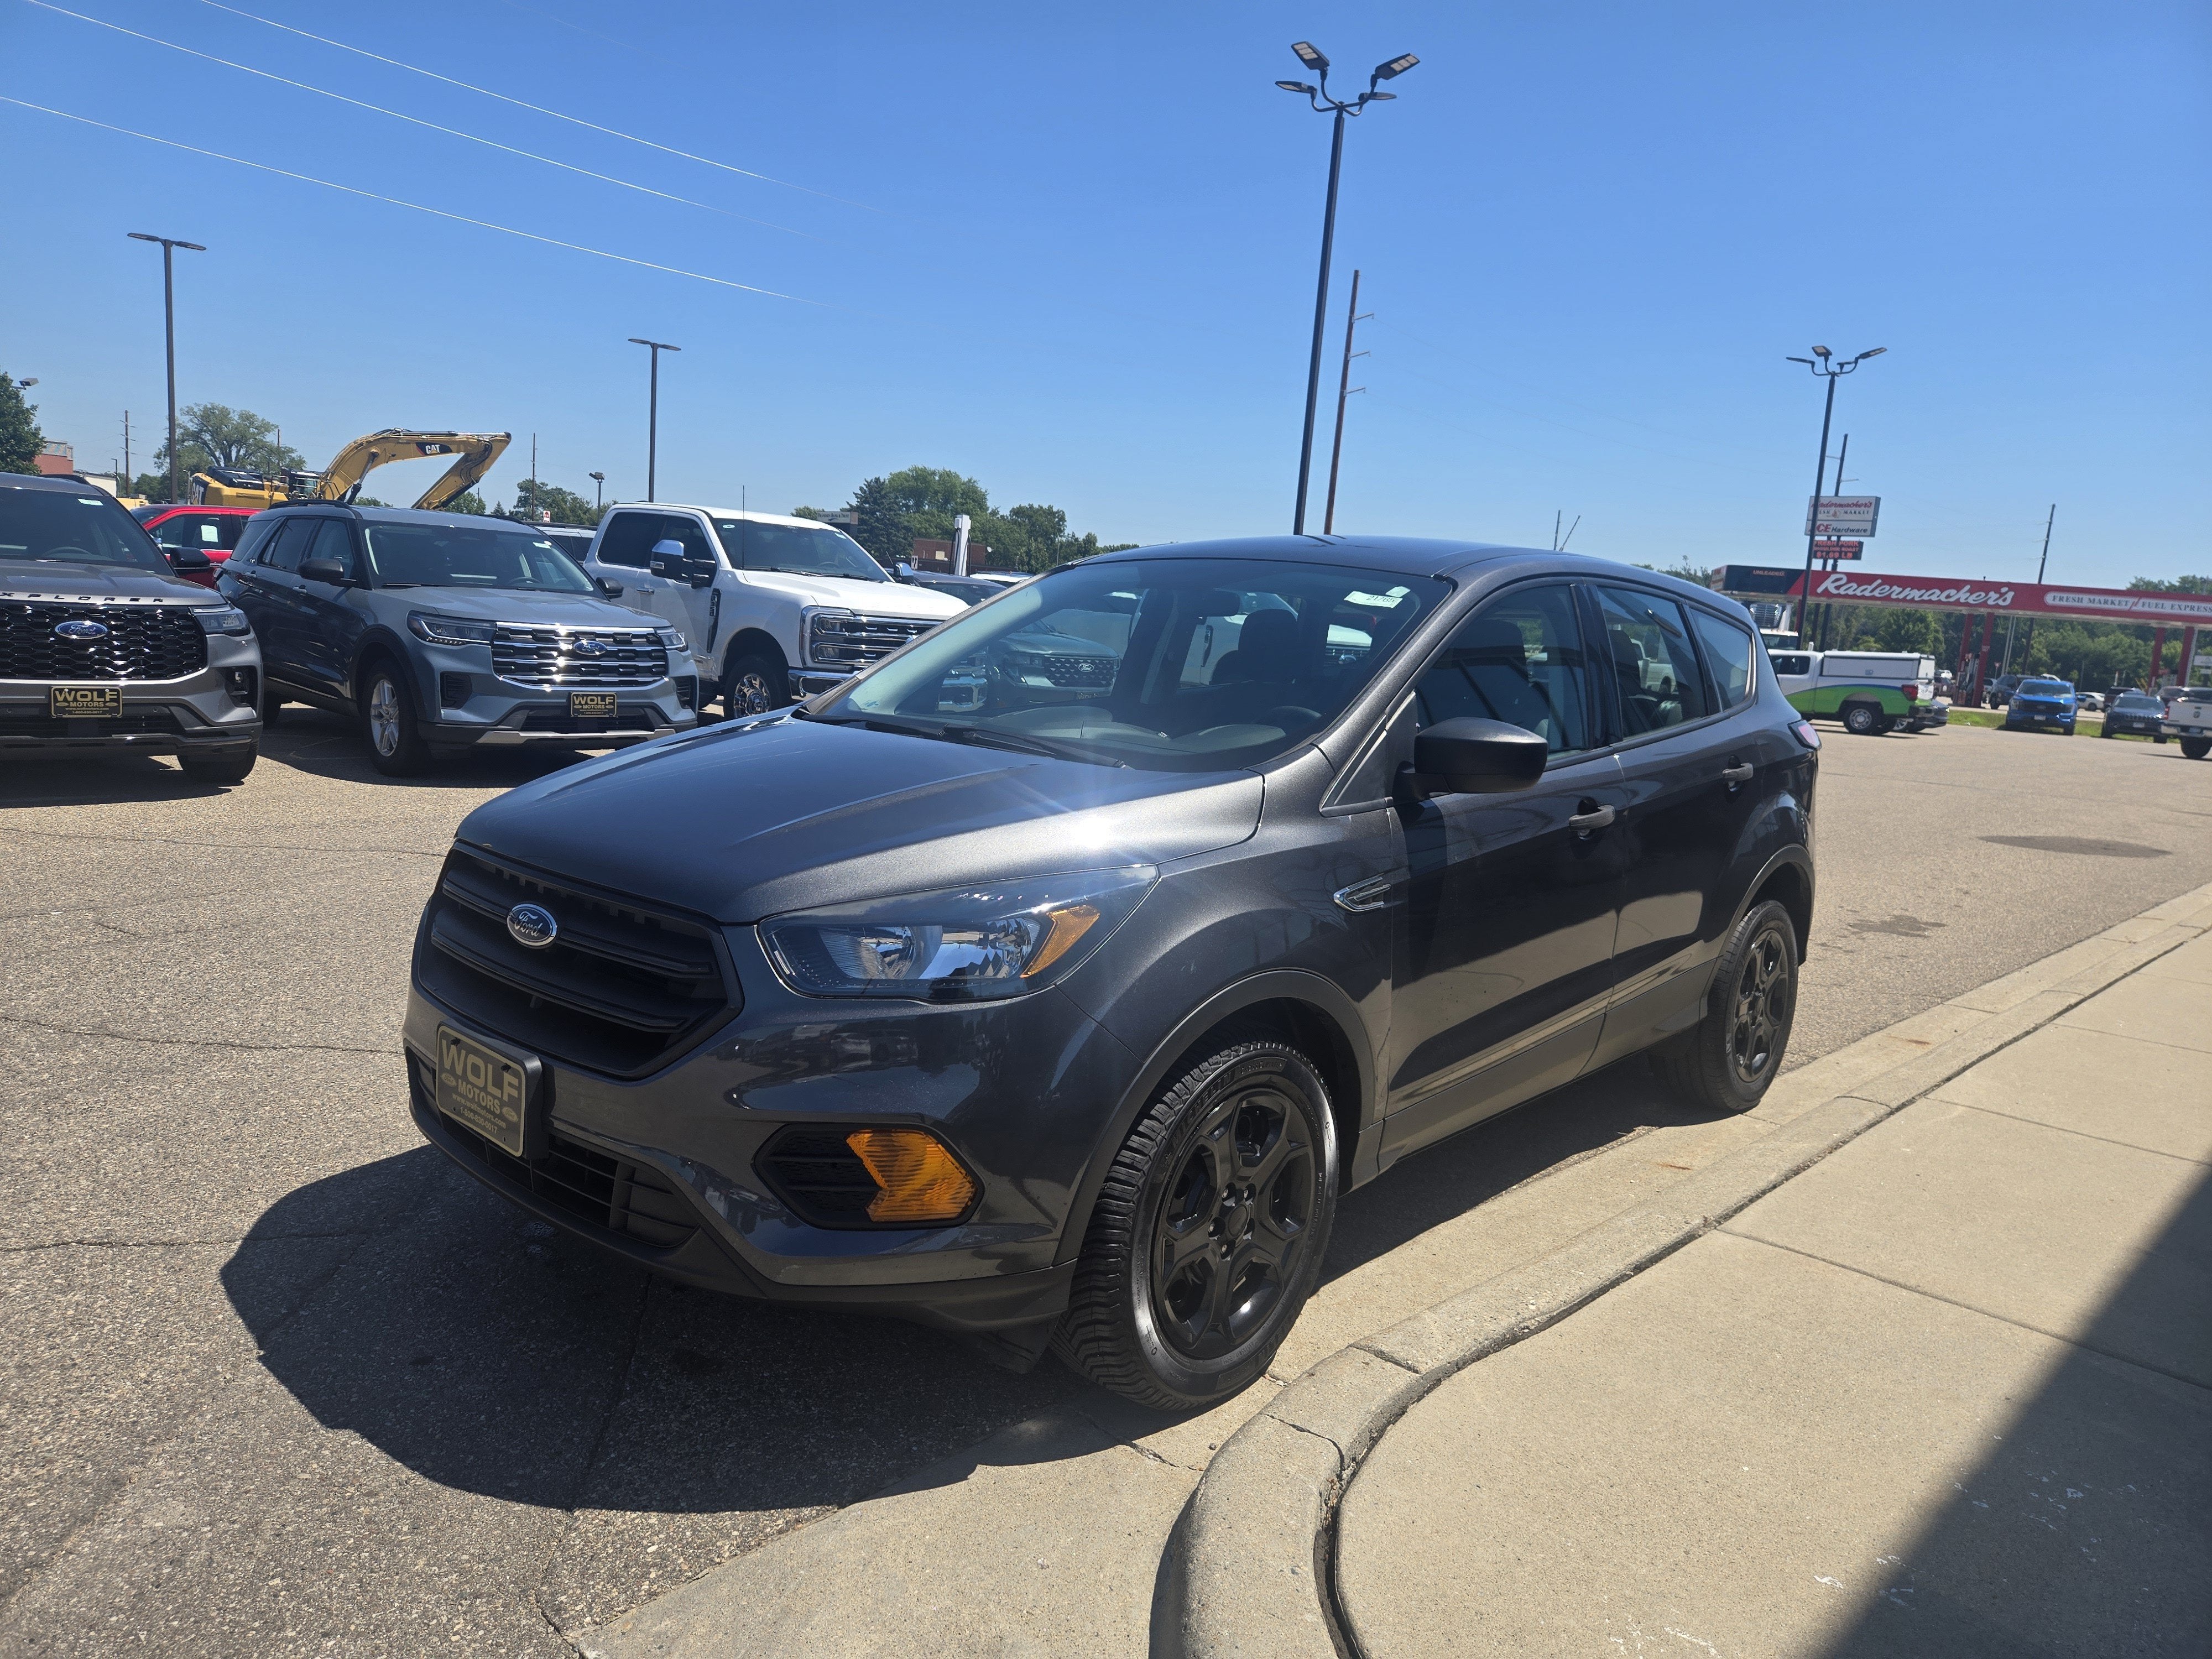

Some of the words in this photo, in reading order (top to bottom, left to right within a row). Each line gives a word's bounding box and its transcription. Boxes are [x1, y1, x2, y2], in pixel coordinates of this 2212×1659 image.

[425, 444, 441, 455] CAT
[191, 482, 204, 505] CAT
[0, 592, 164, 603] XPLORER
[1817, 573, 2015, 606] Radermacher's
[2053, 595, 2084, 603] FRESH
[2088, 598, 2129, 607] MARKET
[2142, 601, 2166, 609] FUEL
[55, 691, 118, 702] WOLF
[573, 696, 614, 705] WOLF
[441, 1038, 519, 1102] WOLF
[457, 1079, 500, 1114] MOTORS
[452, 1093, 507, 1129] www.wolfmotors.com
[460, 1107, 498, 1134] 1-800-830-0017
